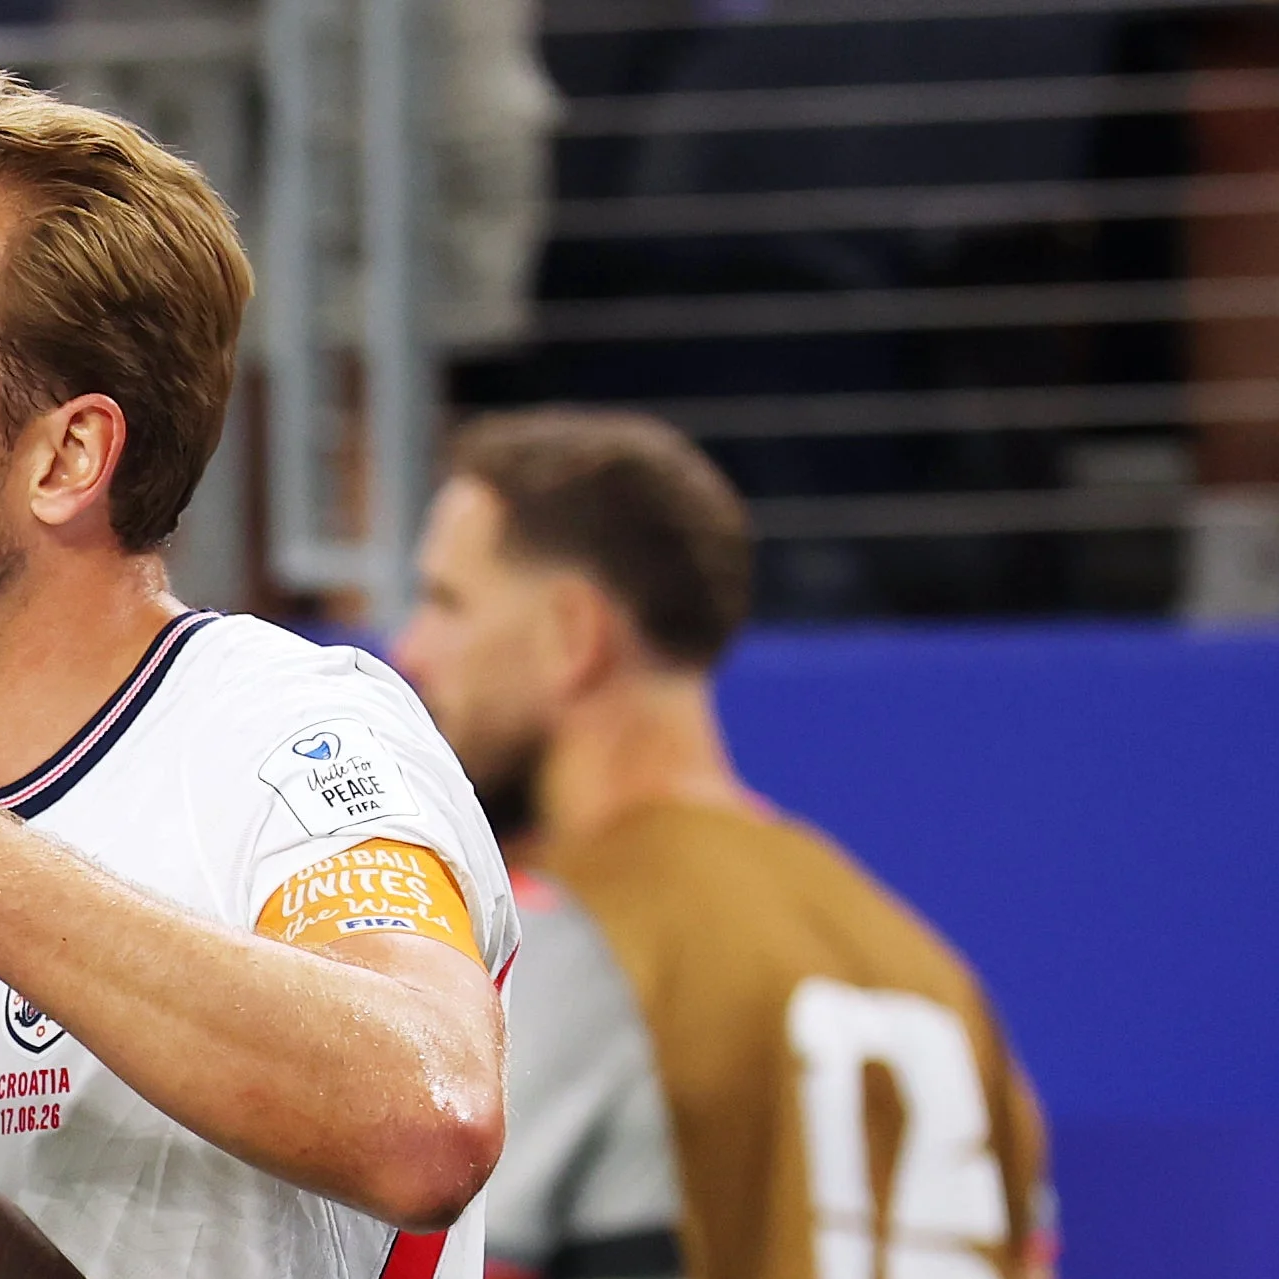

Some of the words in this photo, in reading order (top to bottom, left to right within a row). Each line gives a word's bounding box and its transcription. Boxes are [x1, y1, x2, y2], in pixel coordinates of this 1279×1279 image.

[307, 763, 349, 791] Unite
[346, 755, 371, 774] For
[322, 776, 385, 808] PEACE
[347, 800, 381, 816] FIFA
[282, 869, 432, 917] UNITES
[343, 897, 453, 934] World
[346, 918, 410, 929] FIFA
[0, 1103, 60, 1135] 17.06.26
